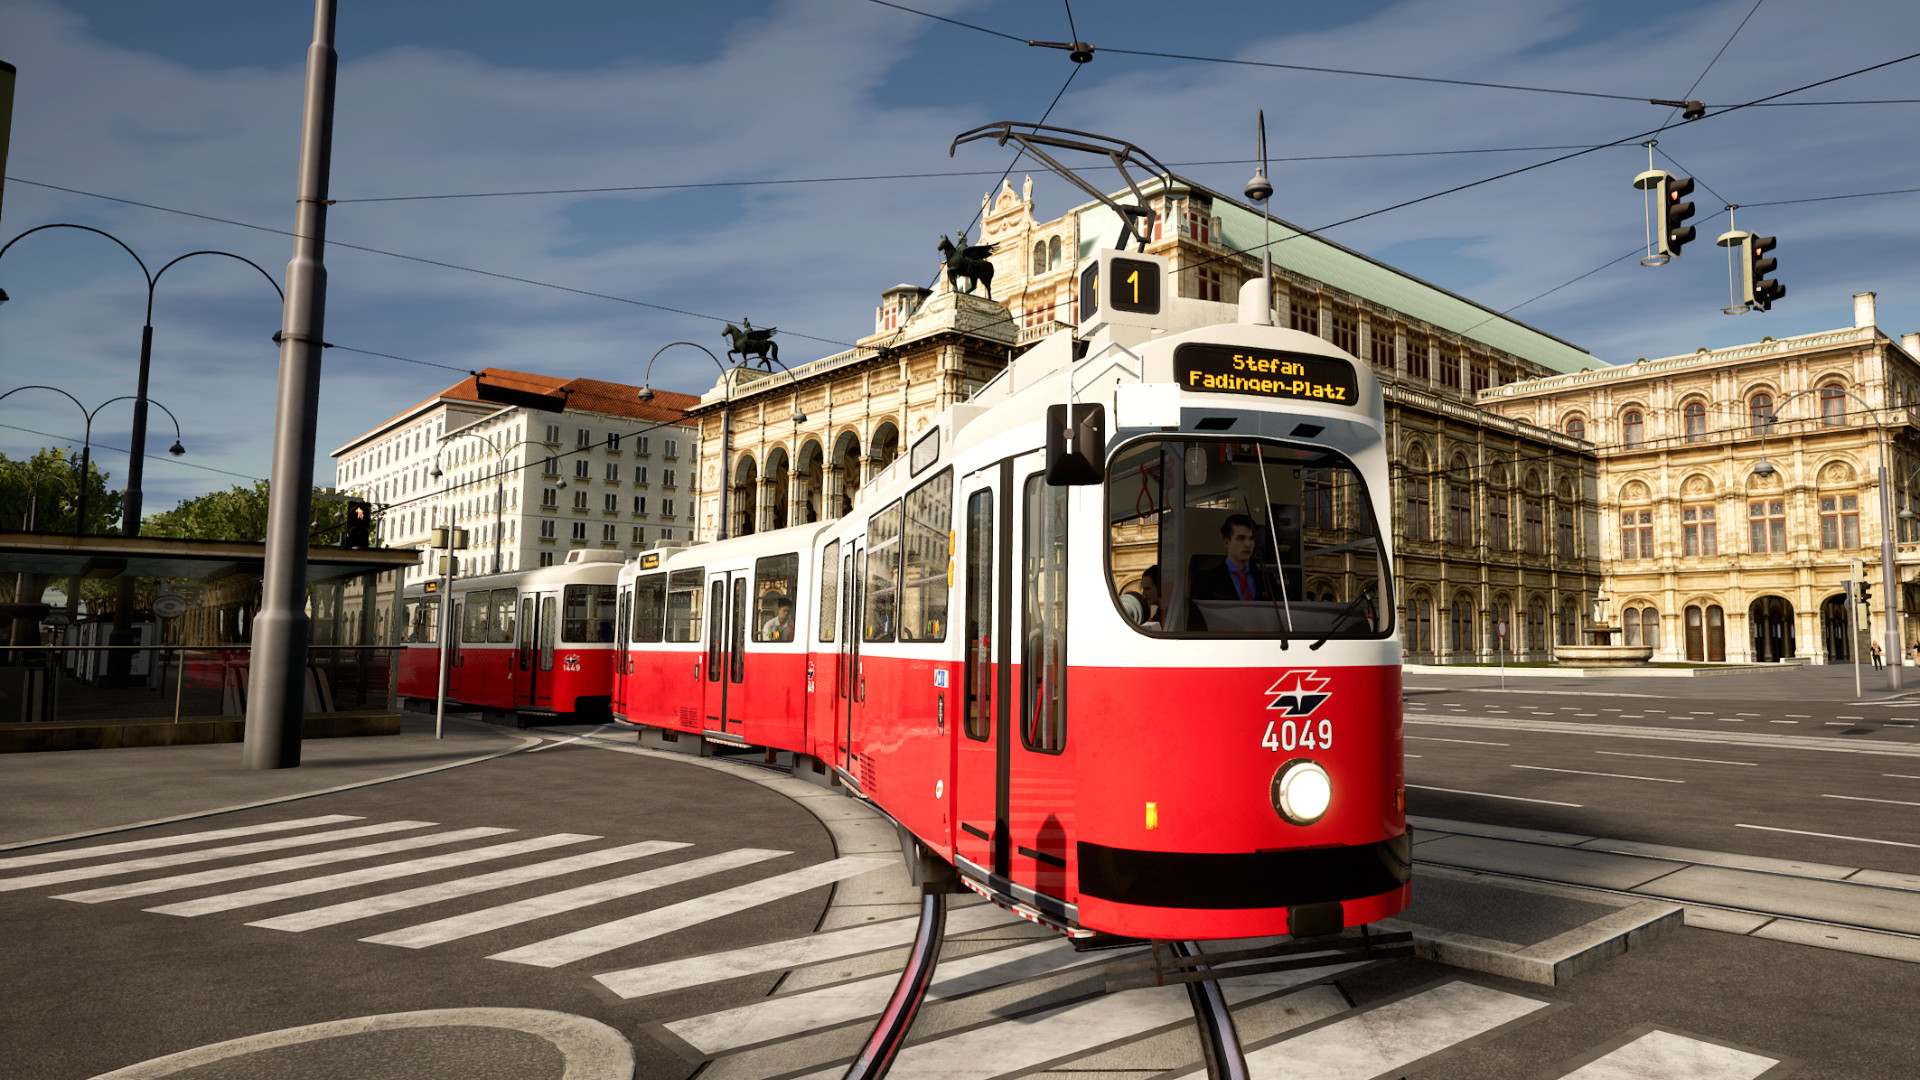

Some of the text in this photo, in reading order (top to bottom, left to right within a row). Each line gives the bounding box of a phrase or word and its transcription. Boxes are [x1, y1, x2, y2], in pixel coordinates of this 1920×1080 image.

[1127, 270, 1139, 304] 1
[1233, 354, 1305, 376] Stefan
[1190, 371, 1346, 400] Fadinger-Platz
[563, 664, 580, 672] 1449
[1261, 719, 1333, 752] 4049
